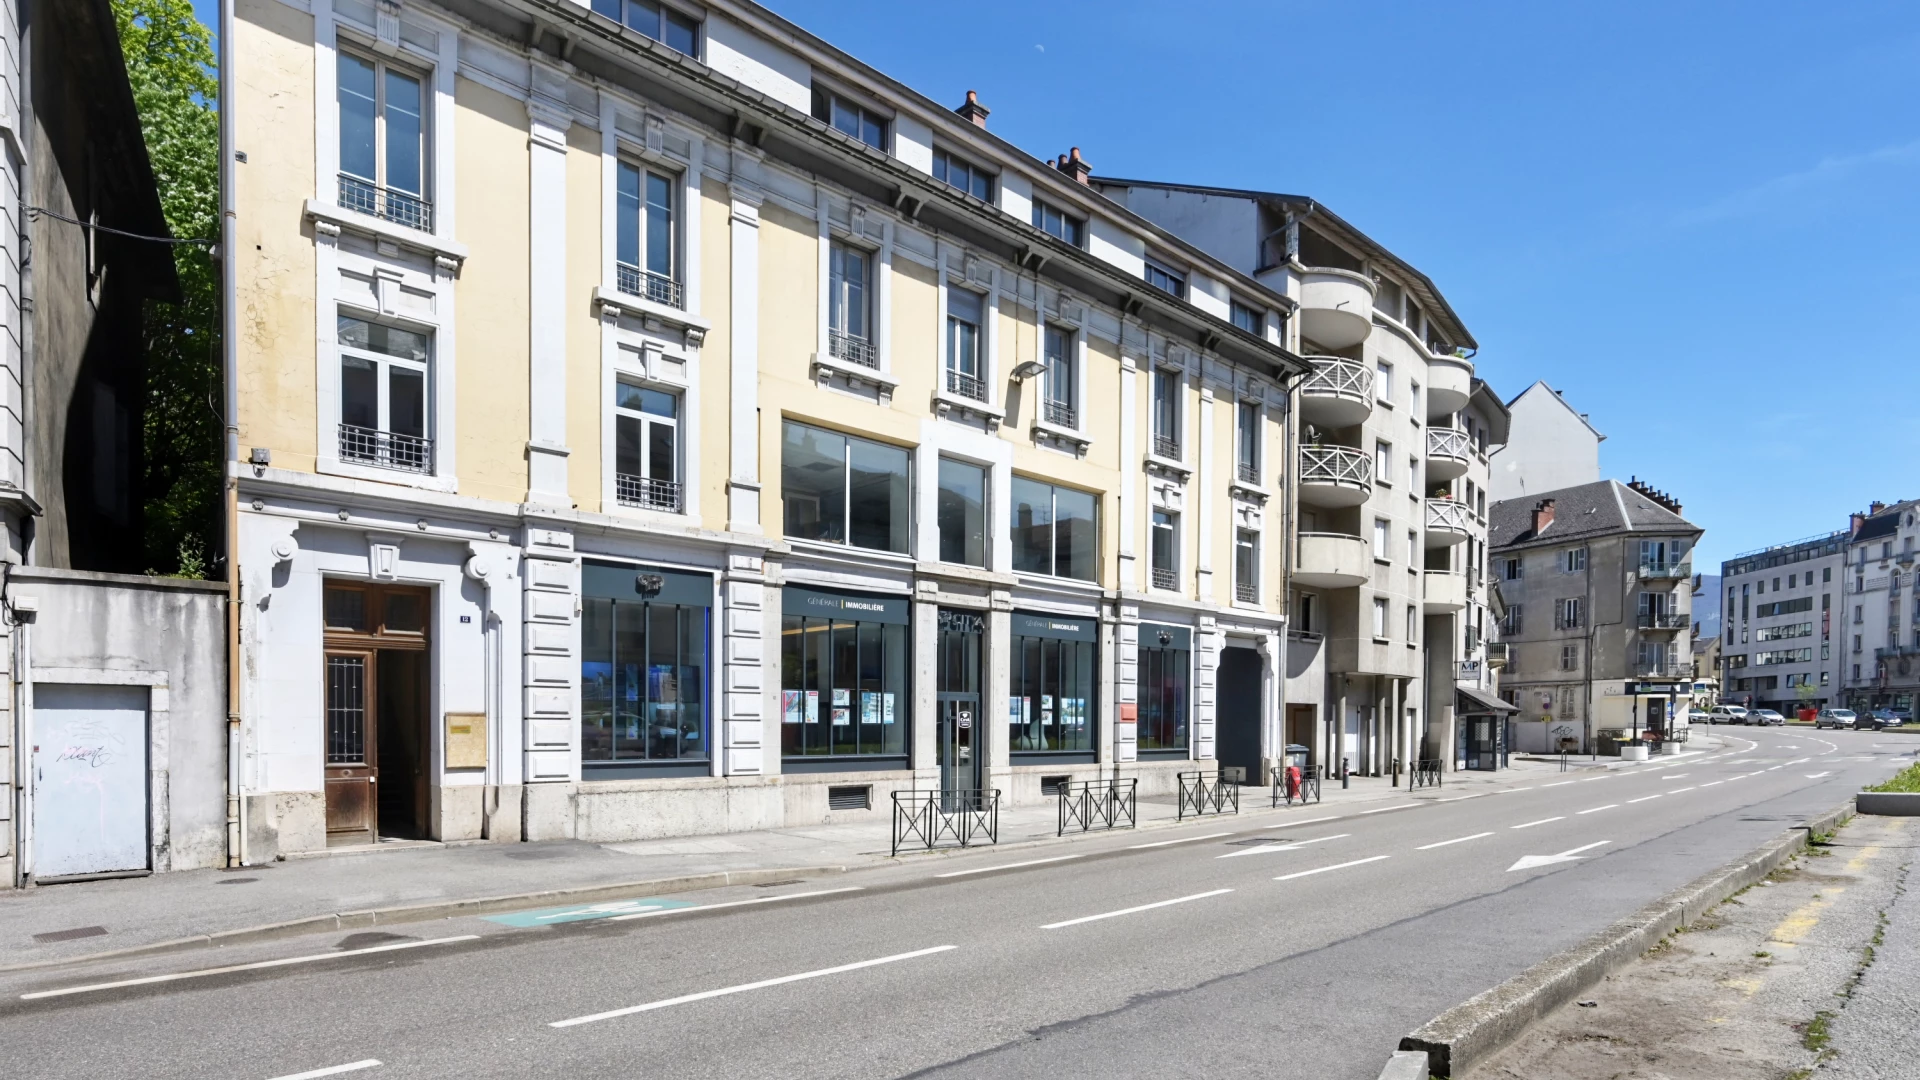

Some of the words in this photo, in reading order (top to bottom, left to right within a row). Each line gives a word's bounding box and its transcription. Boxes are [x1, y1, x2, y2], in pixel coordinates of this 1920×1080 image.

[807, 597, 839, 607] GÉNÉRALE
[845, 601, 884, 611] IMMOBILIÈRE
[953, 614, 985, 628] CITYA
[1461, 661, 1478, 670] MP
